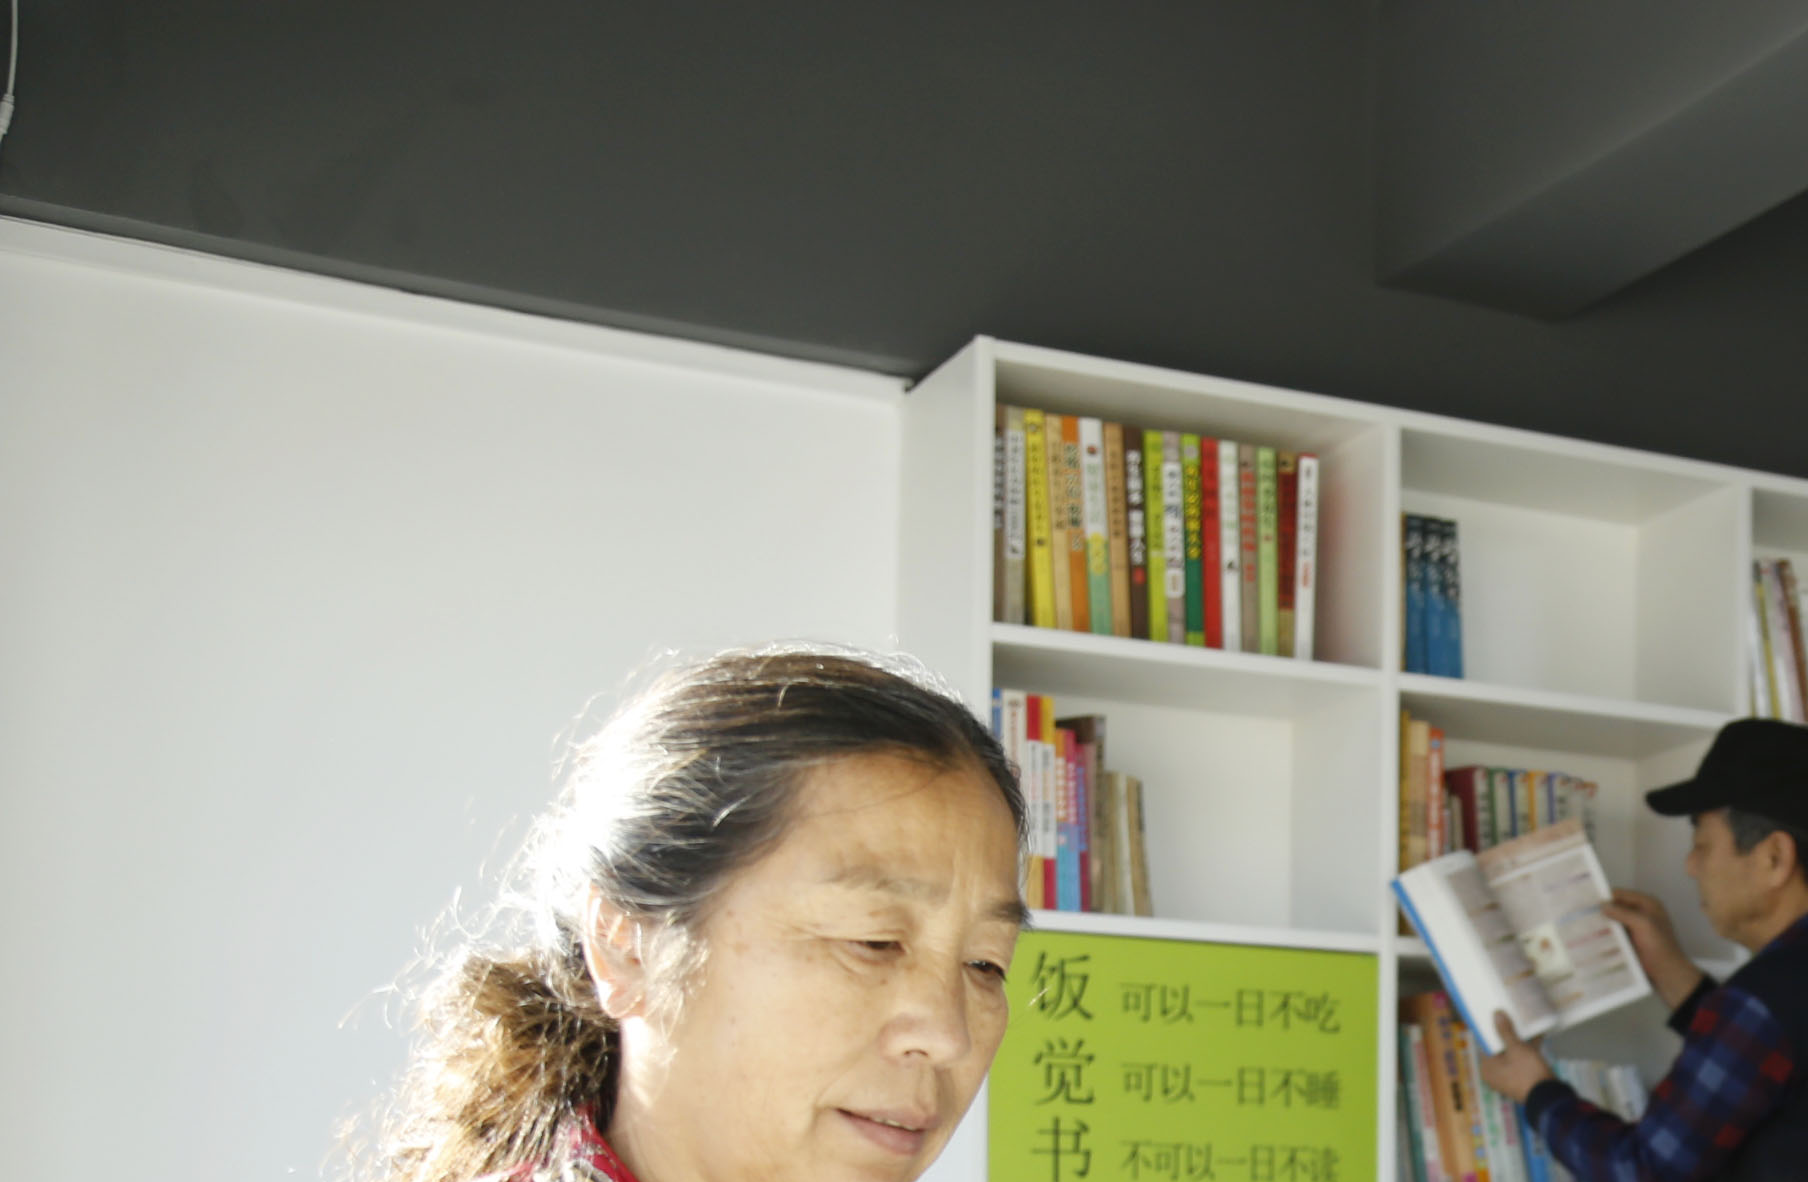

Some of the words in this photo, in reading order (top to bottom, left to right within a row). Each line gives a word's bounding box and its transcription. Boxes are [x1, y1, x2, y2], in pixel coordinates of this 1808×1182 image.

[1030, 950, 1094, 1021] 饭
[1120, 982, 1341, 1034] 可以一日不吃
[1033, 1037, 1095, 1106] 觉
[1121, 1061, 1341, 1110] 可以一日不睡
